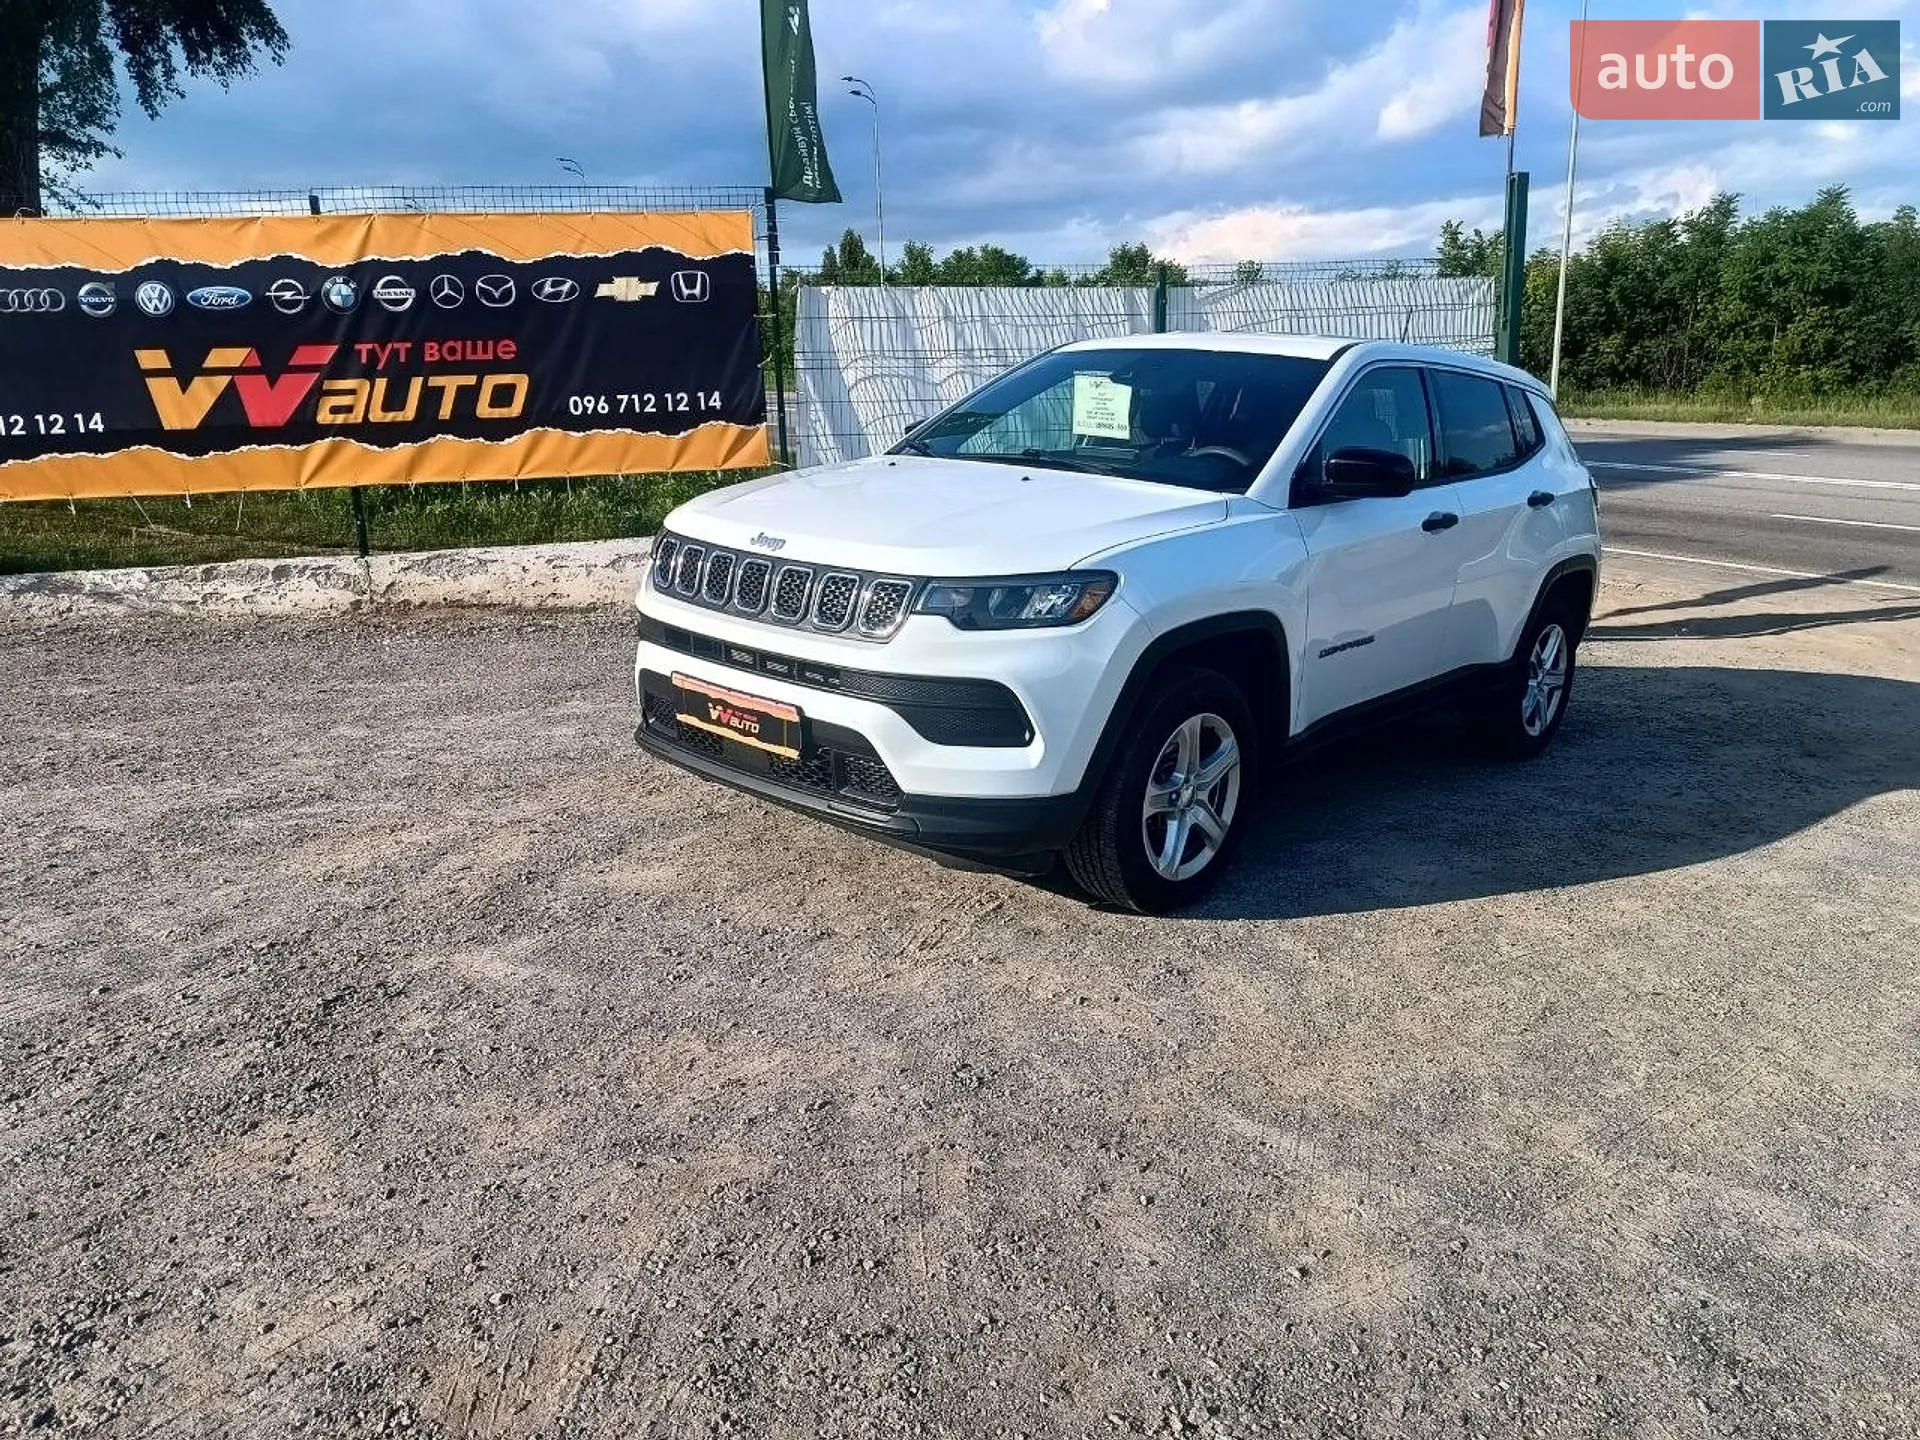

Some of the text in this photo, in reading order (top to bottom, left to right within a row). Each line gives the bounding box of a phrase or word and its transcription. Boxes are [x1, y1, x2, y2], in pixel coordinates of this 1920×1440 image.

[200, 291, 240, 307] Ford
[354, 340, 518, 370] тут ваше
[569, 391, 722, 416] 096 712 12 14
[34, 413, 66, 435] 12
[73, 412, 104, 433] 14
